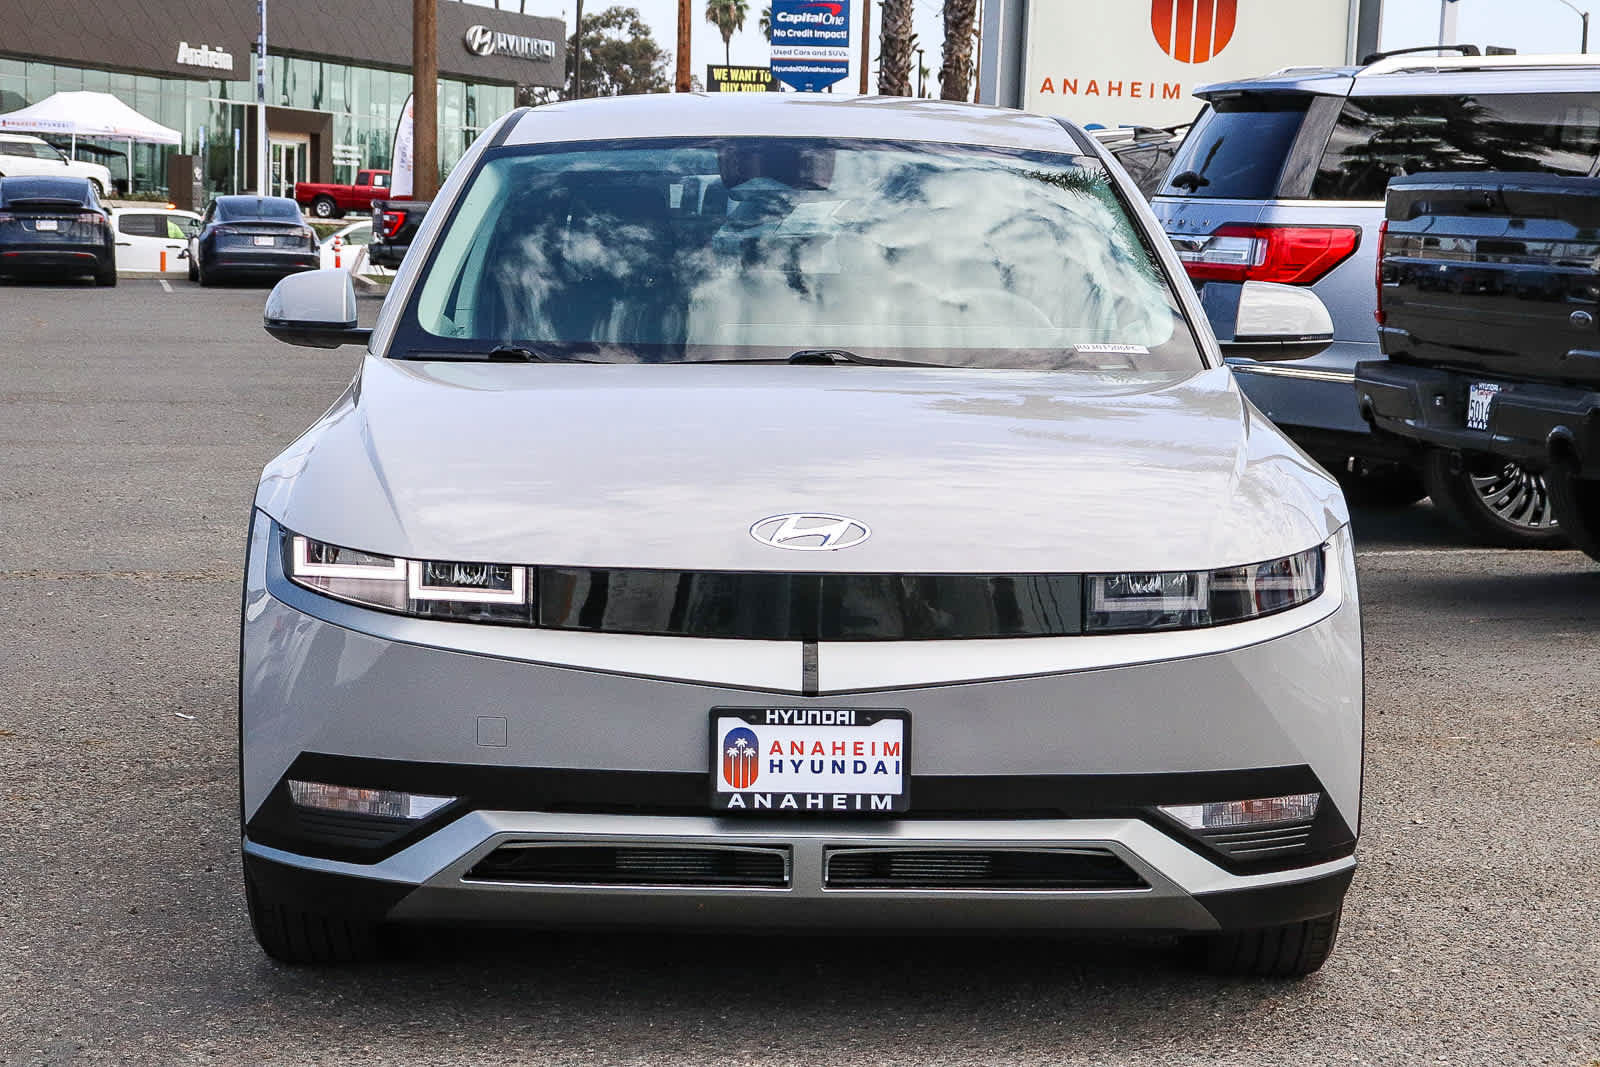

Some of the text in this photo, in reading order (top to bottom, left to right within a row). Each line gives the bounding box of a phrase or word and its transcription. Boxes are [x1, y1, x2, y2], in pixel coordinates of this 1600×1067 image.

[773, 28, 847, 39] No Credit Impact!
[497, 32, 555, 58] HYUNDAI
[176, 41, 233, 70] Anaheim
[713, 68, 772, 83] WE WANT TO
[720, 82, 740, 92] BUY
[1039, 77, 1181, 99] ANAHEIM
[766, 709, 856, 725] HYUNDAI
[769, 740, 900, 757] ANAHEIM
[769, 759, 900, 775] HYUNDAI
[727, 793, 893, 810] ANAHEIM
